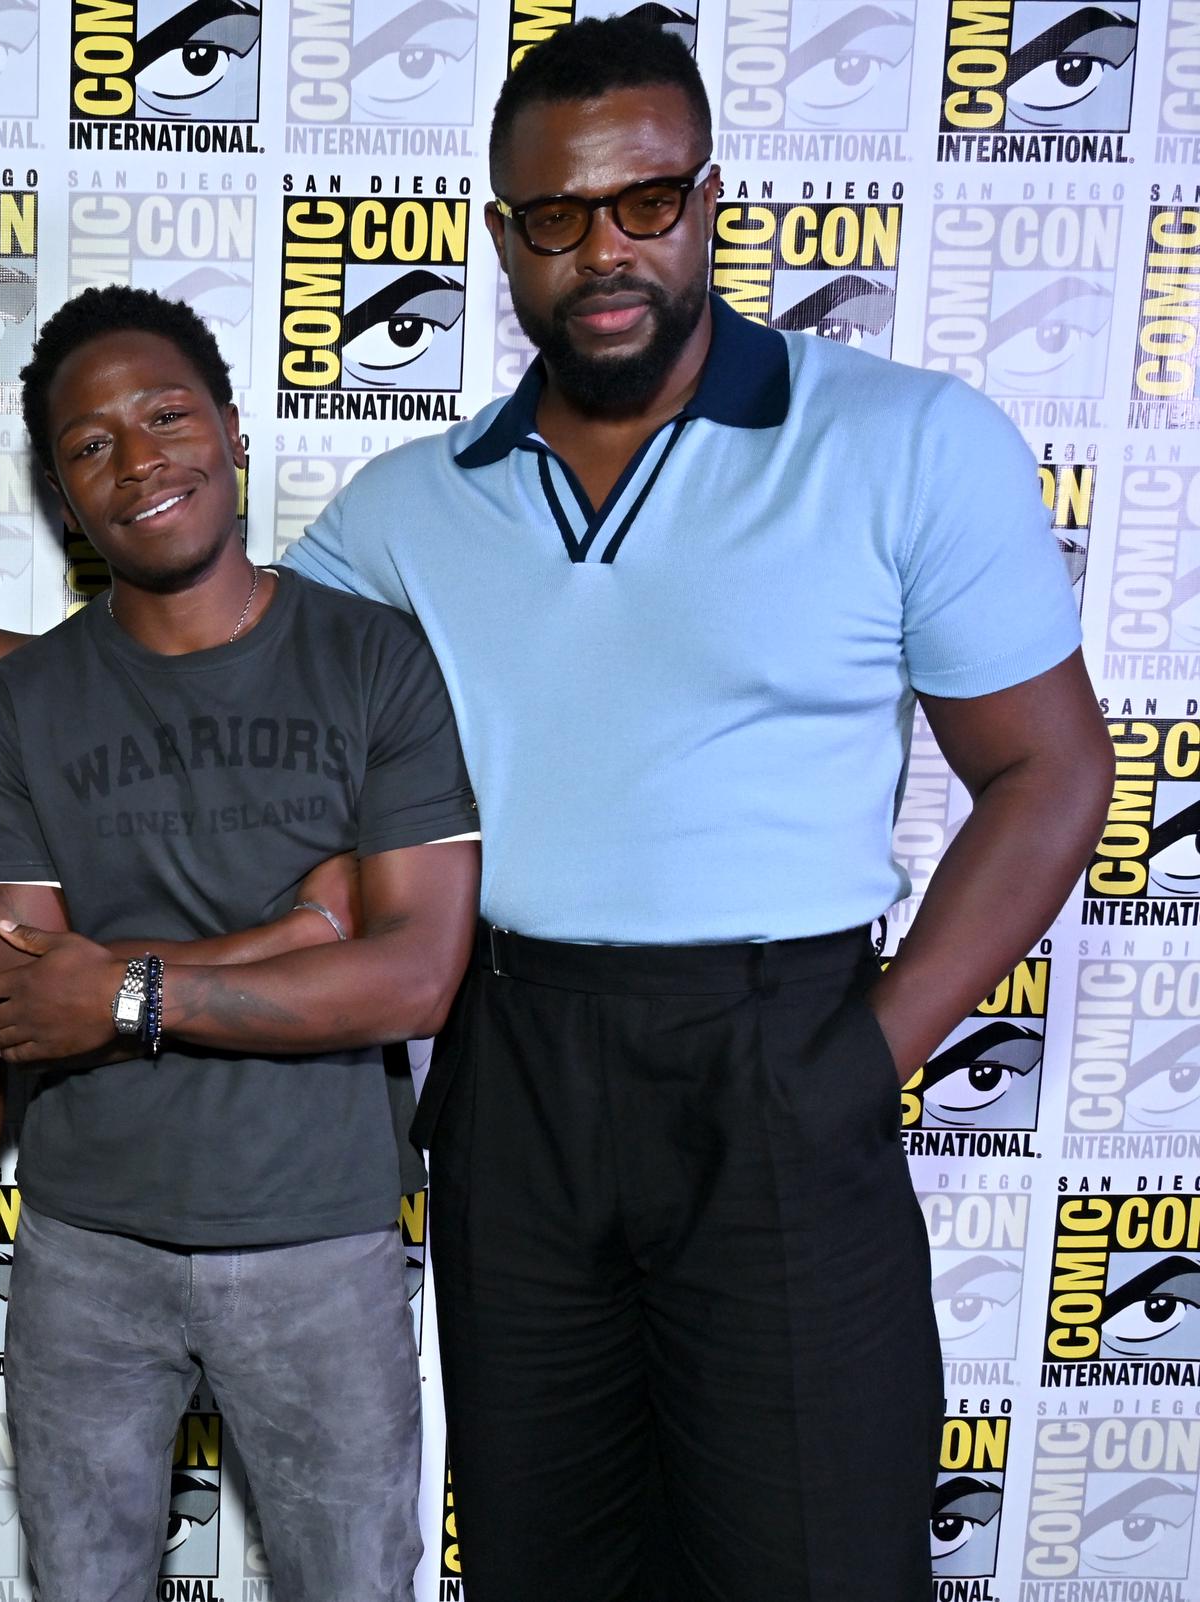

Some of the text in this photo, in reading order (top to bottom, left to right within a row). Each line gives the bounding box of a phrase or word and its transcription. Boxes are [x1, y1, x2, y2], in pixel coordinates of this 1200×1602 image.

[68, 170, 257, 190] SAN DIEGO
[283, 174, 471, 195] SAN DIEGO
[803, 181, 904, 199] DIEGO
[934, 182, 1125, 200] SAN DIEGO
[73, 198, 133, 287] MIC
[136, 197, 252, 259] CON
[350, 201, 465, 263] CON
[780, 206, 899, 267] CON
[1000, 206, 1123, 268] CON
[715, 206, 776, 319] MIC
[283, 201, 345, 387] COMIC
[923, 209, 995, 389] COMIC
[275, 435, 333, 453] SAN
[1123, 444, 1181, 463] SAN
[1111, 469, 1183, 650] COMIC
[1101, 699, 1156, 715] SAN
[63, 716, 350, 801] WARRIORS
[96, 796, 327, 838] CONEY ISLAND
[1078, 939, 1135, 956] SAN
[1069, 964, 1137, 1130] COMIC
[938, 1174, 1032, 1189] DIEGO
[1058, 1176, 1111, 1191] SAN
[925, 1194, 1026, 1248] CON
[1048, 1198, 1112, 1358] COMIC
[1037, 1402, 1089, 1415] SAN
[940, 1420, 1007, 1467] ON
[1093, 1421, 1200, 1471] CON
[1026, 1422, 1089, 1576] COMIC
